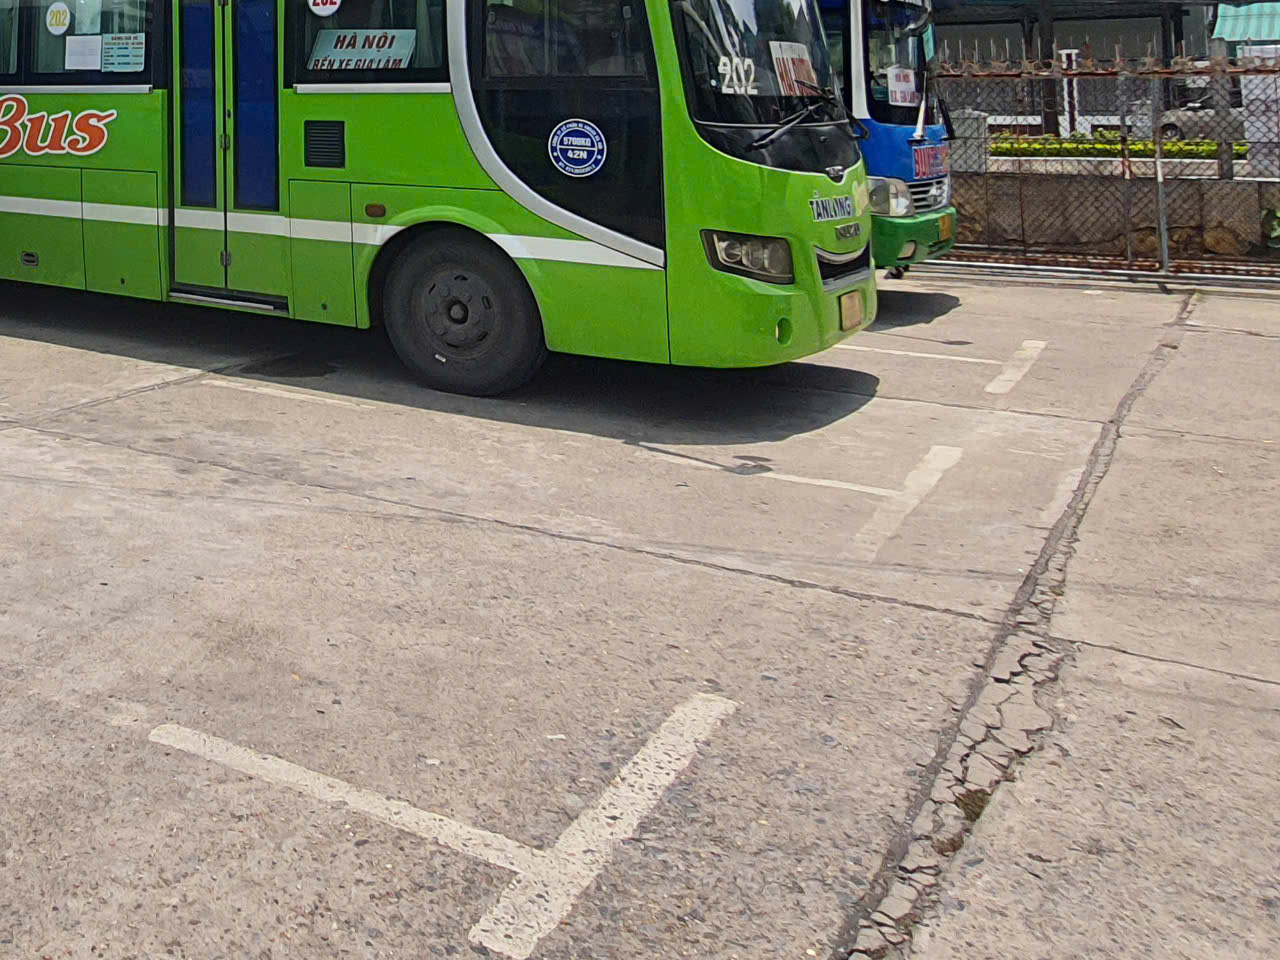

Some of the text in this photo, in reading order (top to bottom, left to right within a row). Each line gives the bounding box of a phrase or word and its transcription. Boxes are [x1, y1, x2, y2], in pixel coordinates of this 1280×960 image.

[48, 8, 68, 27] 202
[332, 32, 397, 53] HÀ NỘI
